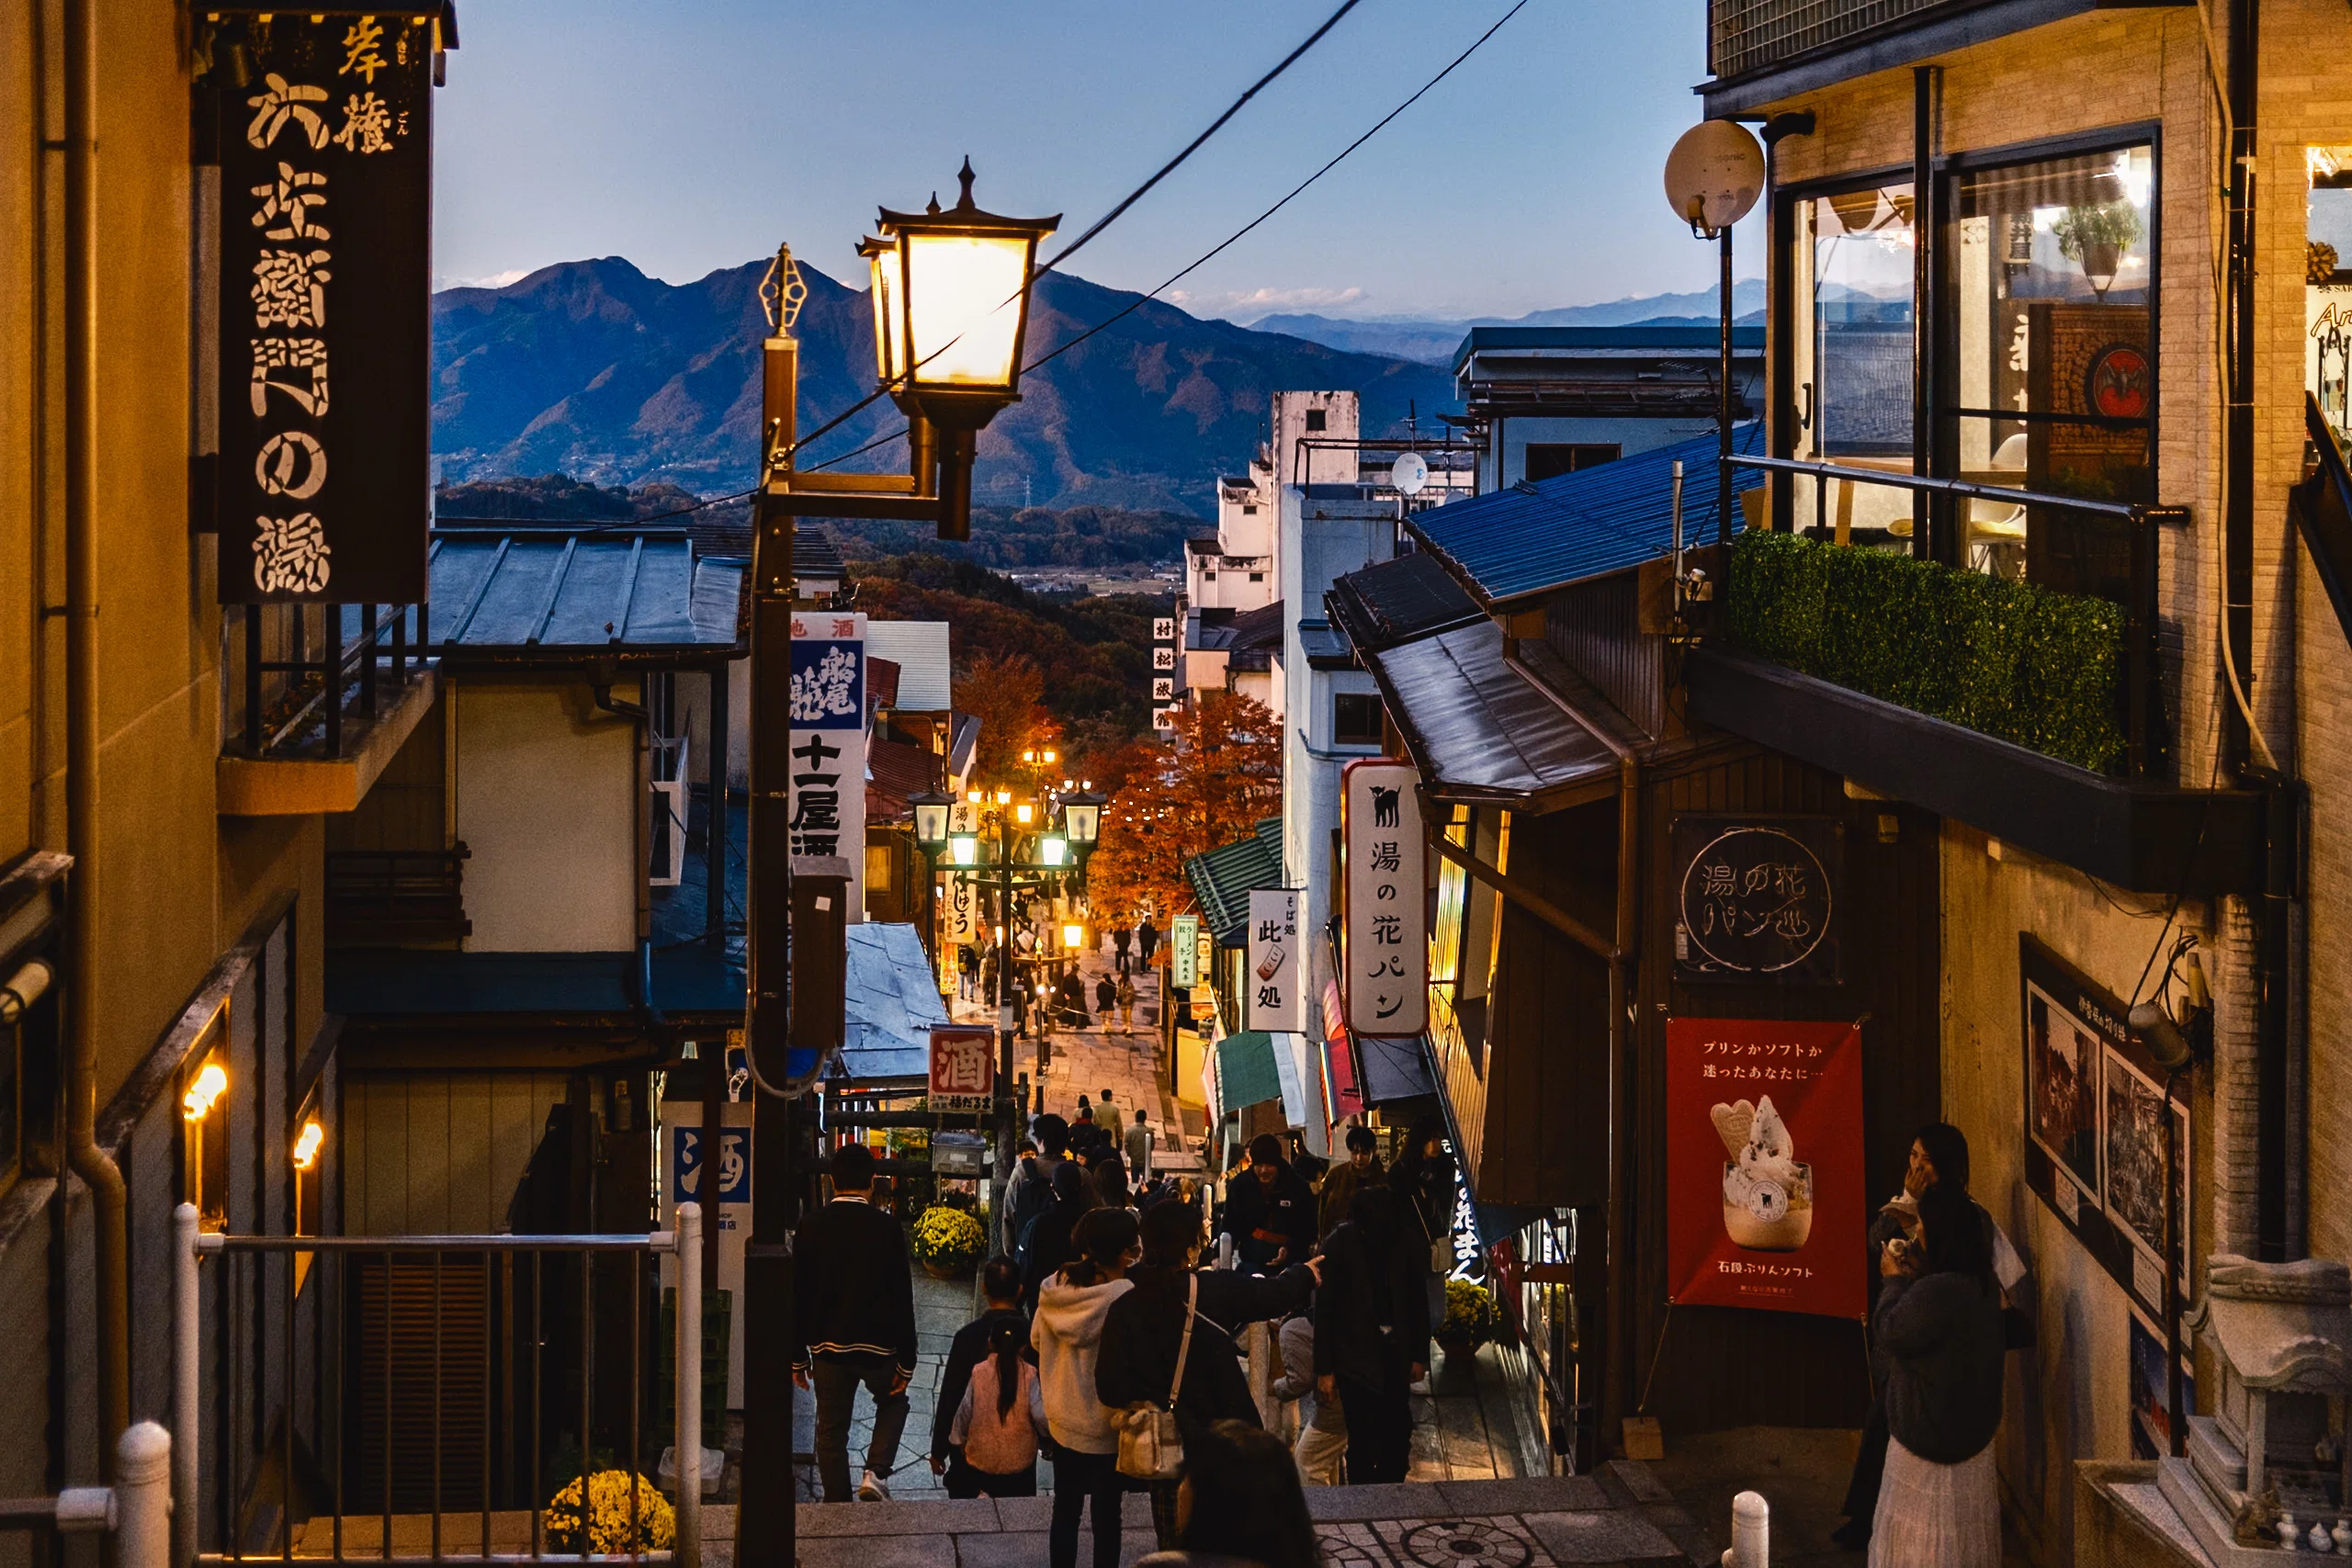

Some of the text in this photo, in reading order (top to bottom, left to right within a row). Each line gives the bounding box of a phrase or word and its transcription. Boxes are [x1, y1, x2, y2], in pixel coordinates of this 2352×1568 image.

[1155, 621, 1171, 726] 村松旅館
[1700, 863, 1804, 897] 湯の花
[1284, 897, 1295, 935] そば処
[1368, 841, 1405, 1019] 湯の花パン
[937, 1038, 987, 1090] 酒
[1703, 1040, 1822, 1057] プリンかソフトか
[949, 1095, 991, 1110] 福だるま
